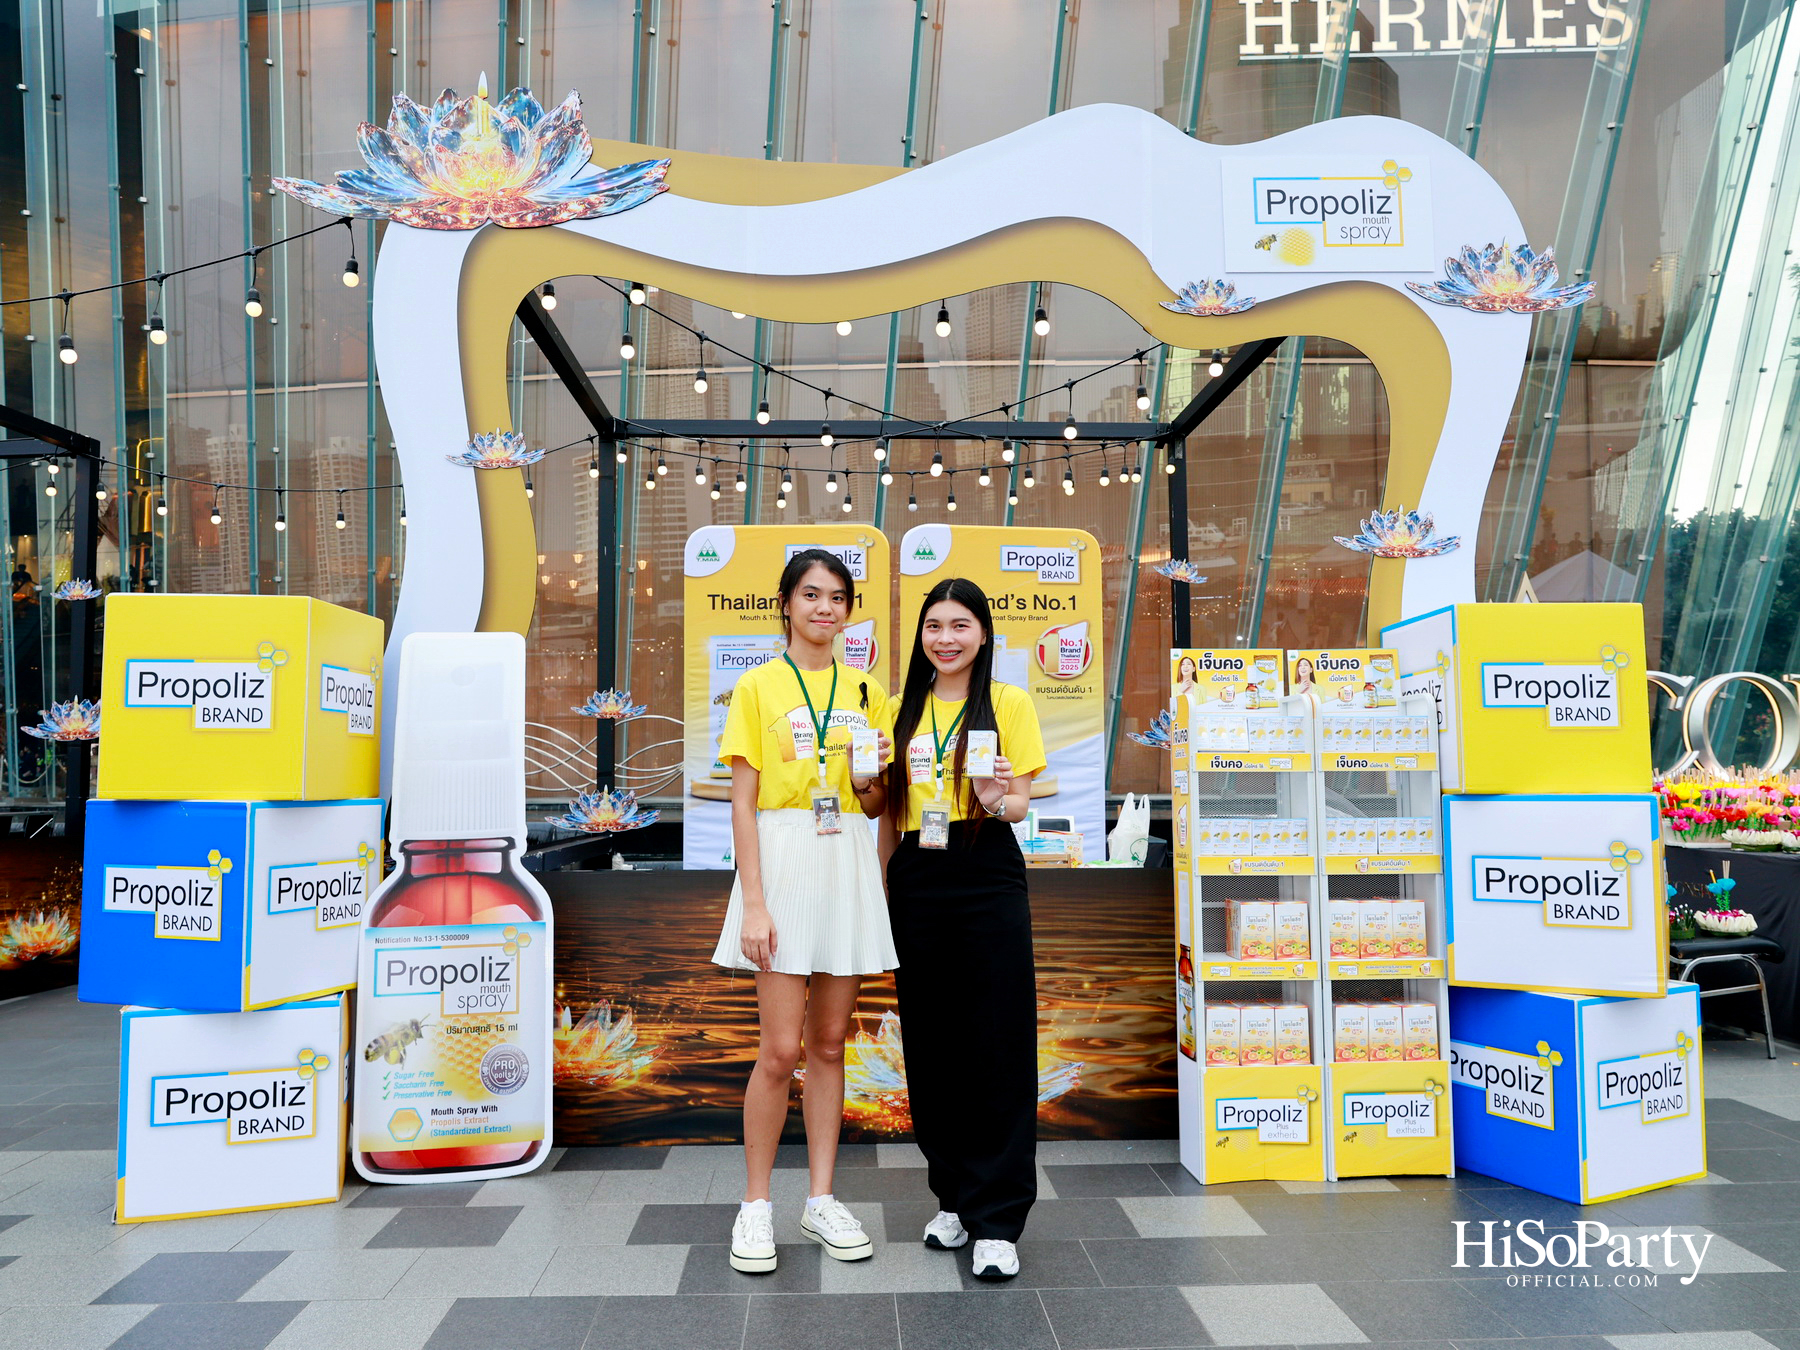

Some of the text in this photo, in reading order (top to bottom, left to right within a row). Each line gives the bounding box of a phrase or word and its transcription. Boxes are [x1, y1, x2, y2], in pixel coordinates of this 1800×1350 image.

[1266, 188, 1392, 221] Propoliz
[1362, 215, 1390, 224] mouth
[1340, 224, 1392, 245] spray
[1007, 552, 1074, 569] Propoliz
[1042, 571, 1074, 580] BRAND
[1034, 594, 1076, 610] No.1
[846, 637, 868, 646] No.1
[722, 654, 778, 668] Propoli
[1199, 652, 1244, 670] เจ็บคอ
[1316, 653, 1360, 670] เจ็บคอ
[138, 671, 265, 705] Propoliz
[326, 676, 373, 712] Propoliz
[1494, 674, 1611, 705] Propoliz
[202, 707, 264, 723] BRAND
[351, 714, 372, 730] BRAND
[1555, 707, 1611, 722] BRAND
[792, 721, 813, 729] No.1
[911, 746, 932, 754] No.1
[1211, 756, 1243, 768] เจ็บคอ
[1336, 756, 1368, 768] เจ็บคอ
[278, 872, 362, 906] Propoliz
[1485, 867, 1620, 902] Propoliz
[112, 876, 214, 912] Propoliz
[322, 902, 362, 922] BRAND
[1554, 904, 1620, 920] BRAND
[162, 915, 212, 932] BRAND
[386, 956, 510, 992] Propoliz
[480, 983, 511, 994] mouth
[457, 993, 508, 1014] spray
[495, 1060, 515, 1070] PRO
[1606, 1062, 1682, 1100] Propoliz
[166, 1080, 306, 1118] Propoliz
[393, 1090, 434, 1099] Preservative
[457, 1107, 478, 1115] Spray
[1351, 1100, 1430, 1123] Propoliz
[1494, 1094, 1545, 1118] BRAND
[1647, 1095, 1683, 1115] BRAND
[431, 1116, 488, 1126] Propolis Extract
[1224, 1105, 1303, 1126] Propoliz
[238, 1115, 305, 1135] BRAND
[431, 1125, 511, 1137] (Standardized Extract)
[1396, 1126, 1425, 1134] extherb
[1268, 1130, 1298, 1139] extherb
